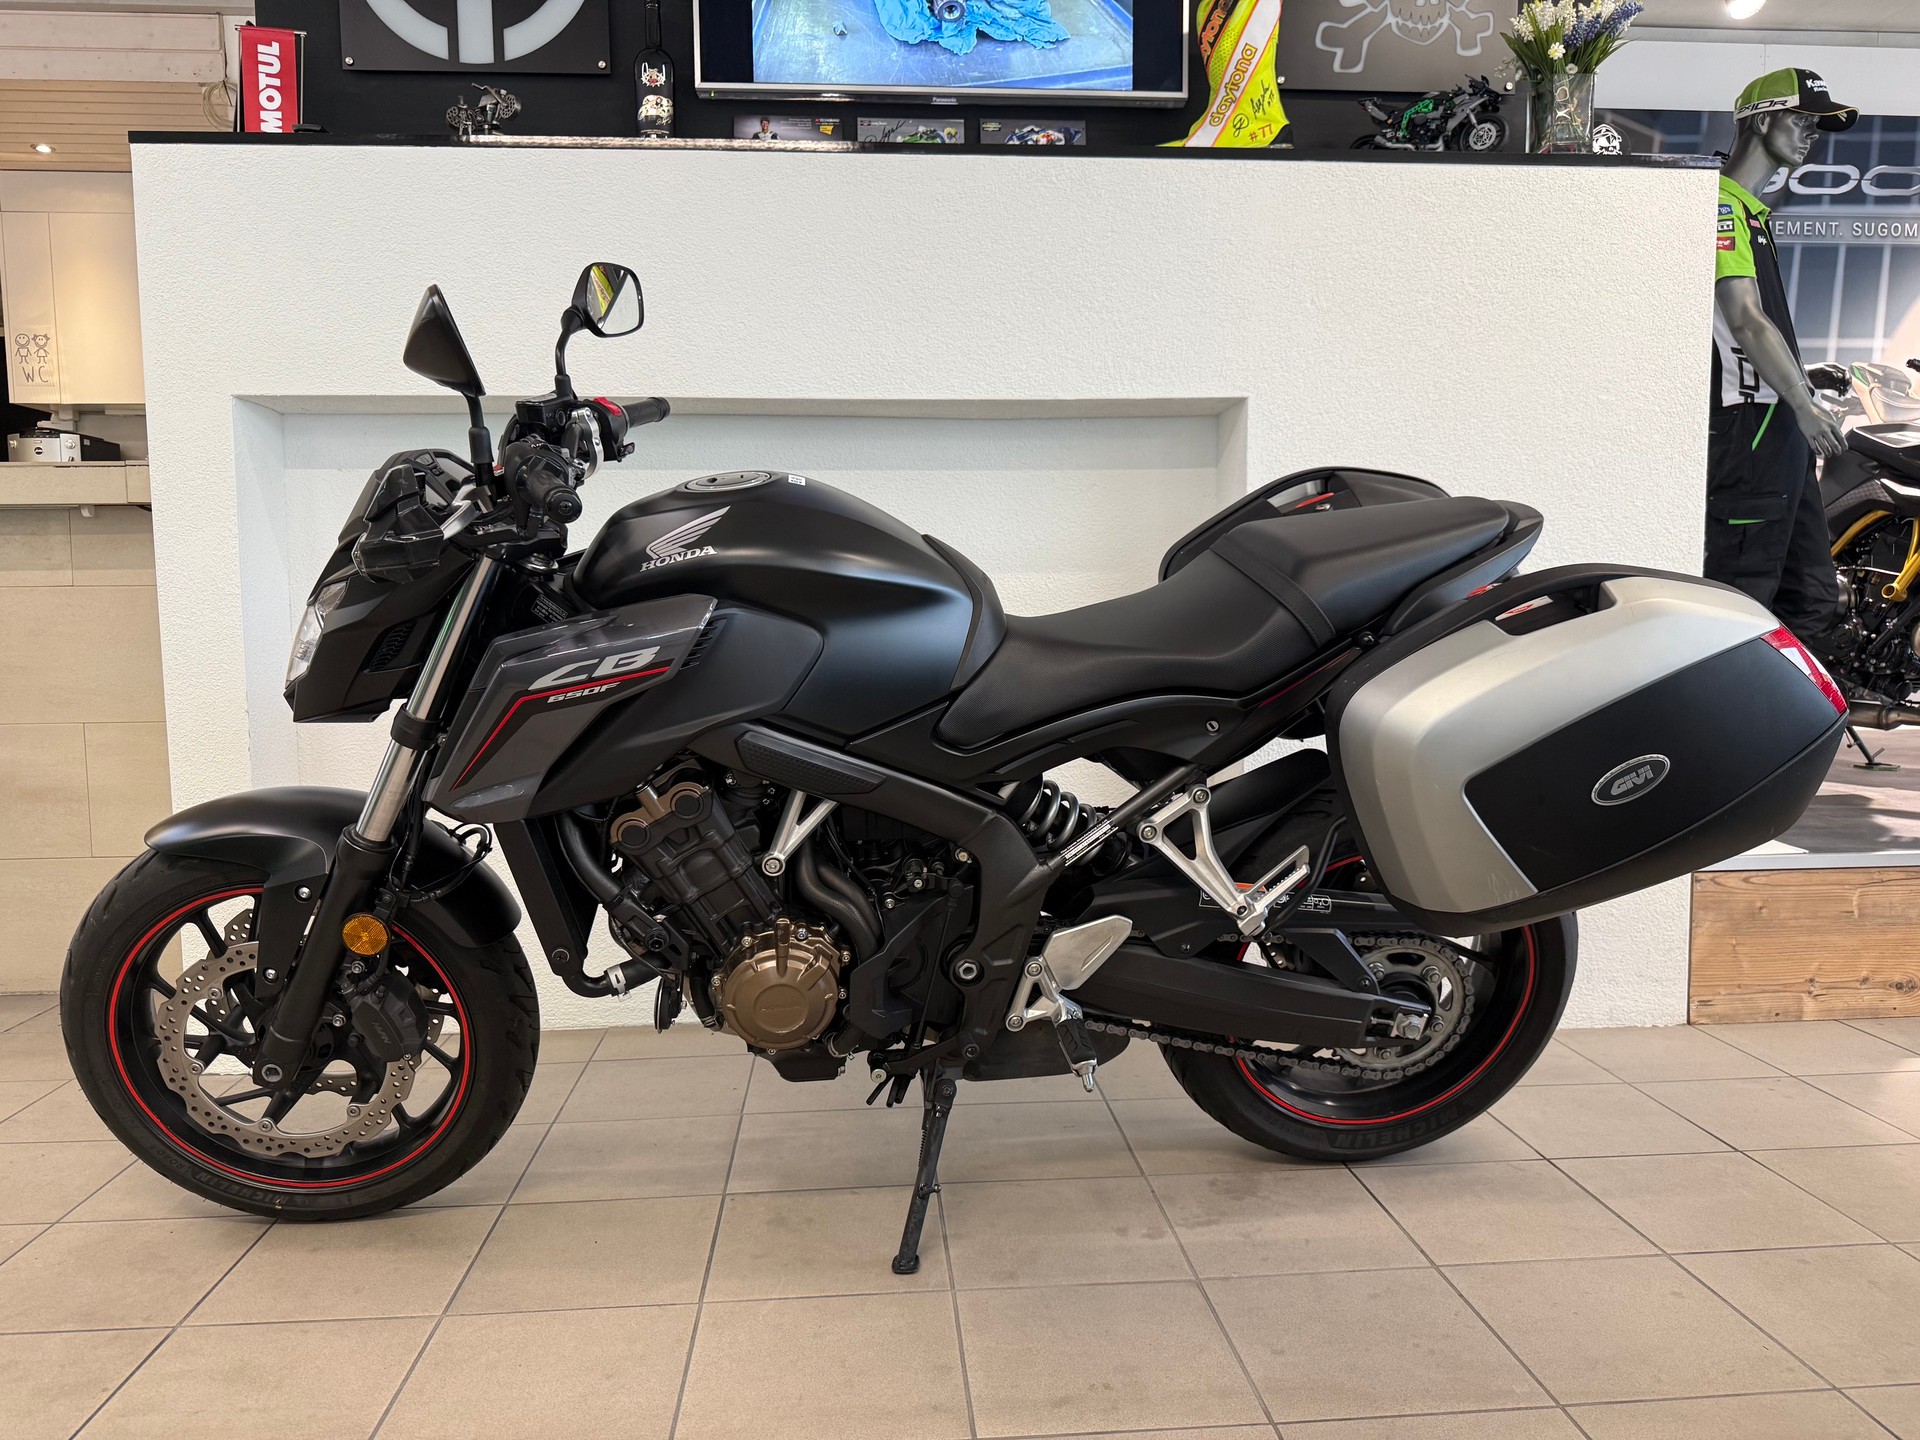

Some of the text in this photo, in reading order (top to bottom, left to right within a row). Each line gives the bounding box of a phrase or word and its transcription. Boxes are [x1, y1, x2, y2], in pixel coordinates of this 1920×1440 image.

[257, 41, 282, 132] MOTUL
[1209, 43, 1258, 127] daytona
[1852, 222, 1918, 238] SUGOM
[22, 365, 49, 382] WC
[639, 545, 718, 573] HONDA
[527, 646, 661, 691] CB
[547, 682, 621, 703] 650F
[1610, 764, 1654, 796] GIVI
[1335, 1104, 1460, 1150] MICHELIN
[194, 1170, 289, 1206] MICHELIN
